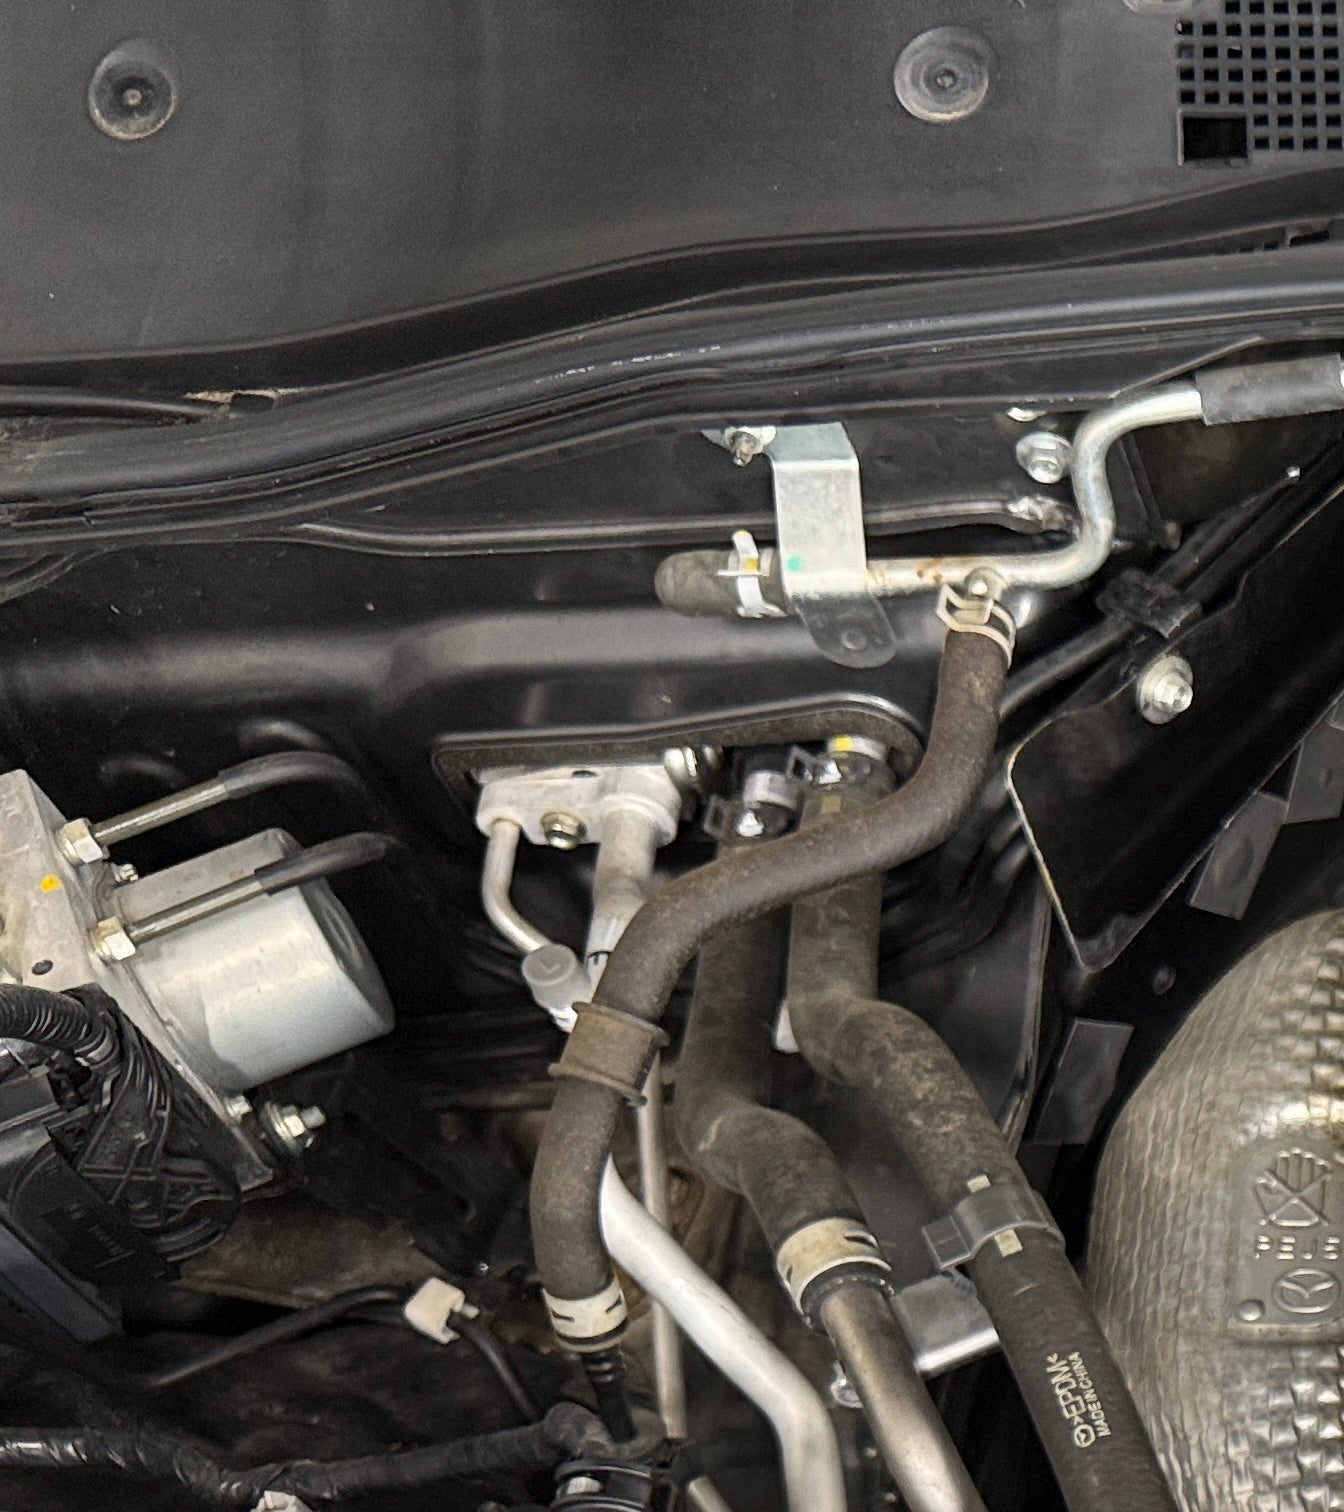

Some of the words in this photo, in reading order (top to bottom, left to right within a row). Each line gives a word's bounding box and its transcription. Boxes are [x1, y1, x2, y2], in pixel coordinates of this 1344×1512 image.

[1068, 1351, 1092, 1389] CHINA
[1082, 1388, 1097, 1402] IN
[1088, 1401, 1111, 1437] MADE
